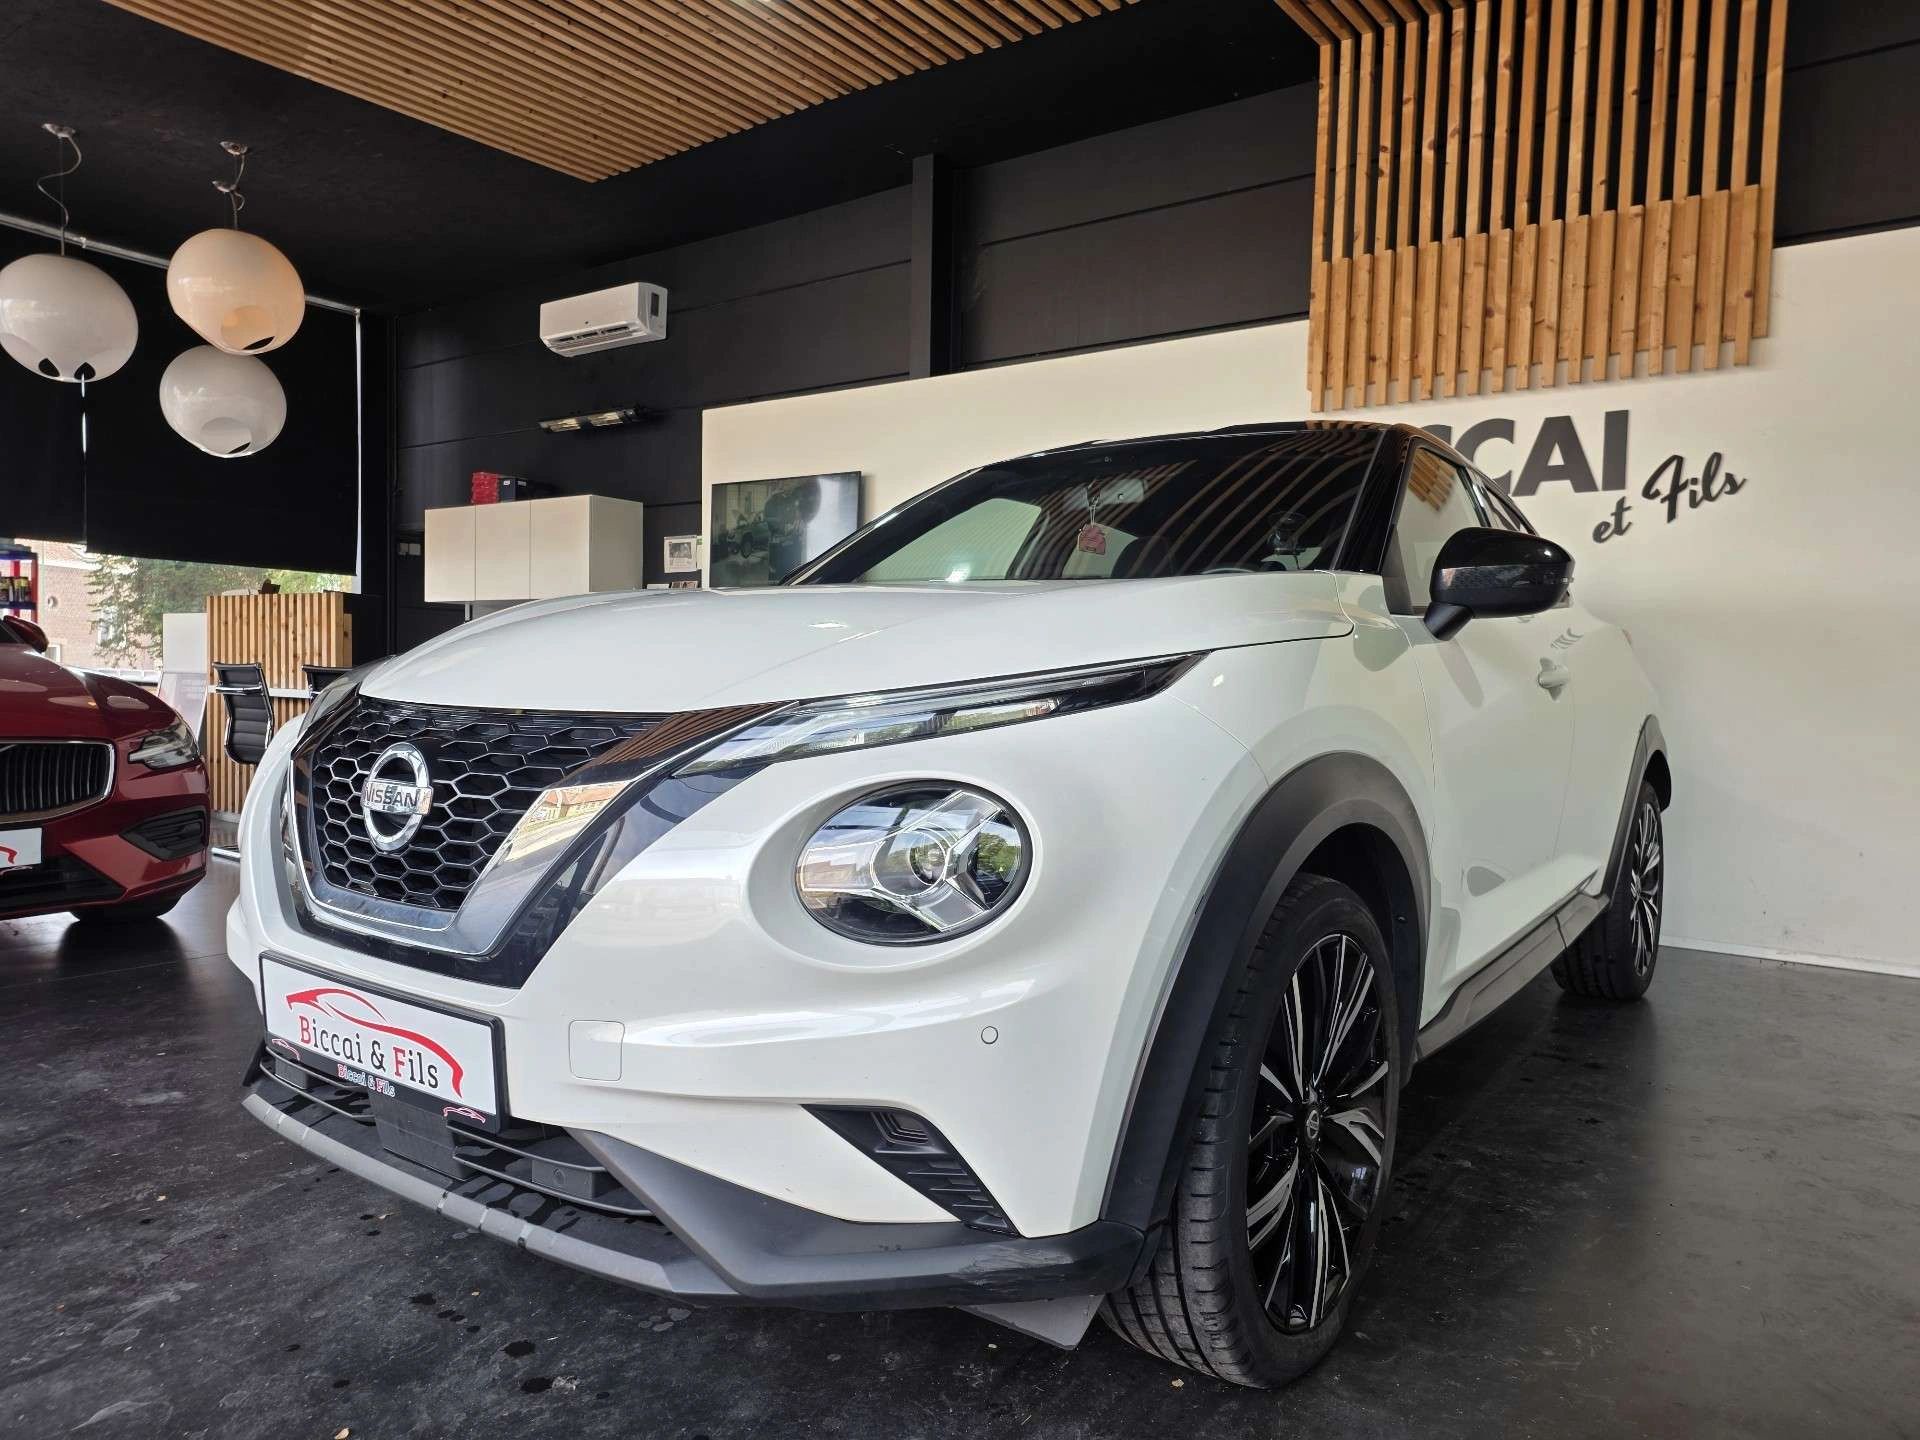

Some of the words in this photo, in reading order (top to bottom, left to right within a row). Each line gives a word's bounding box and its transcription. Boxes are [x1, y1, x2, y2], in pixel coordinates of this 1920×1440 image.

[1420, 409, 1629, 498] CAI
[1592, 496, 1632, 543] et
[1641, 452, 1747, 524] Fils
[299, 1015, 363, 1063] Biccai
[370, 1040, 386, 1073] &
[392, 1046, 439, 1089] Fils
